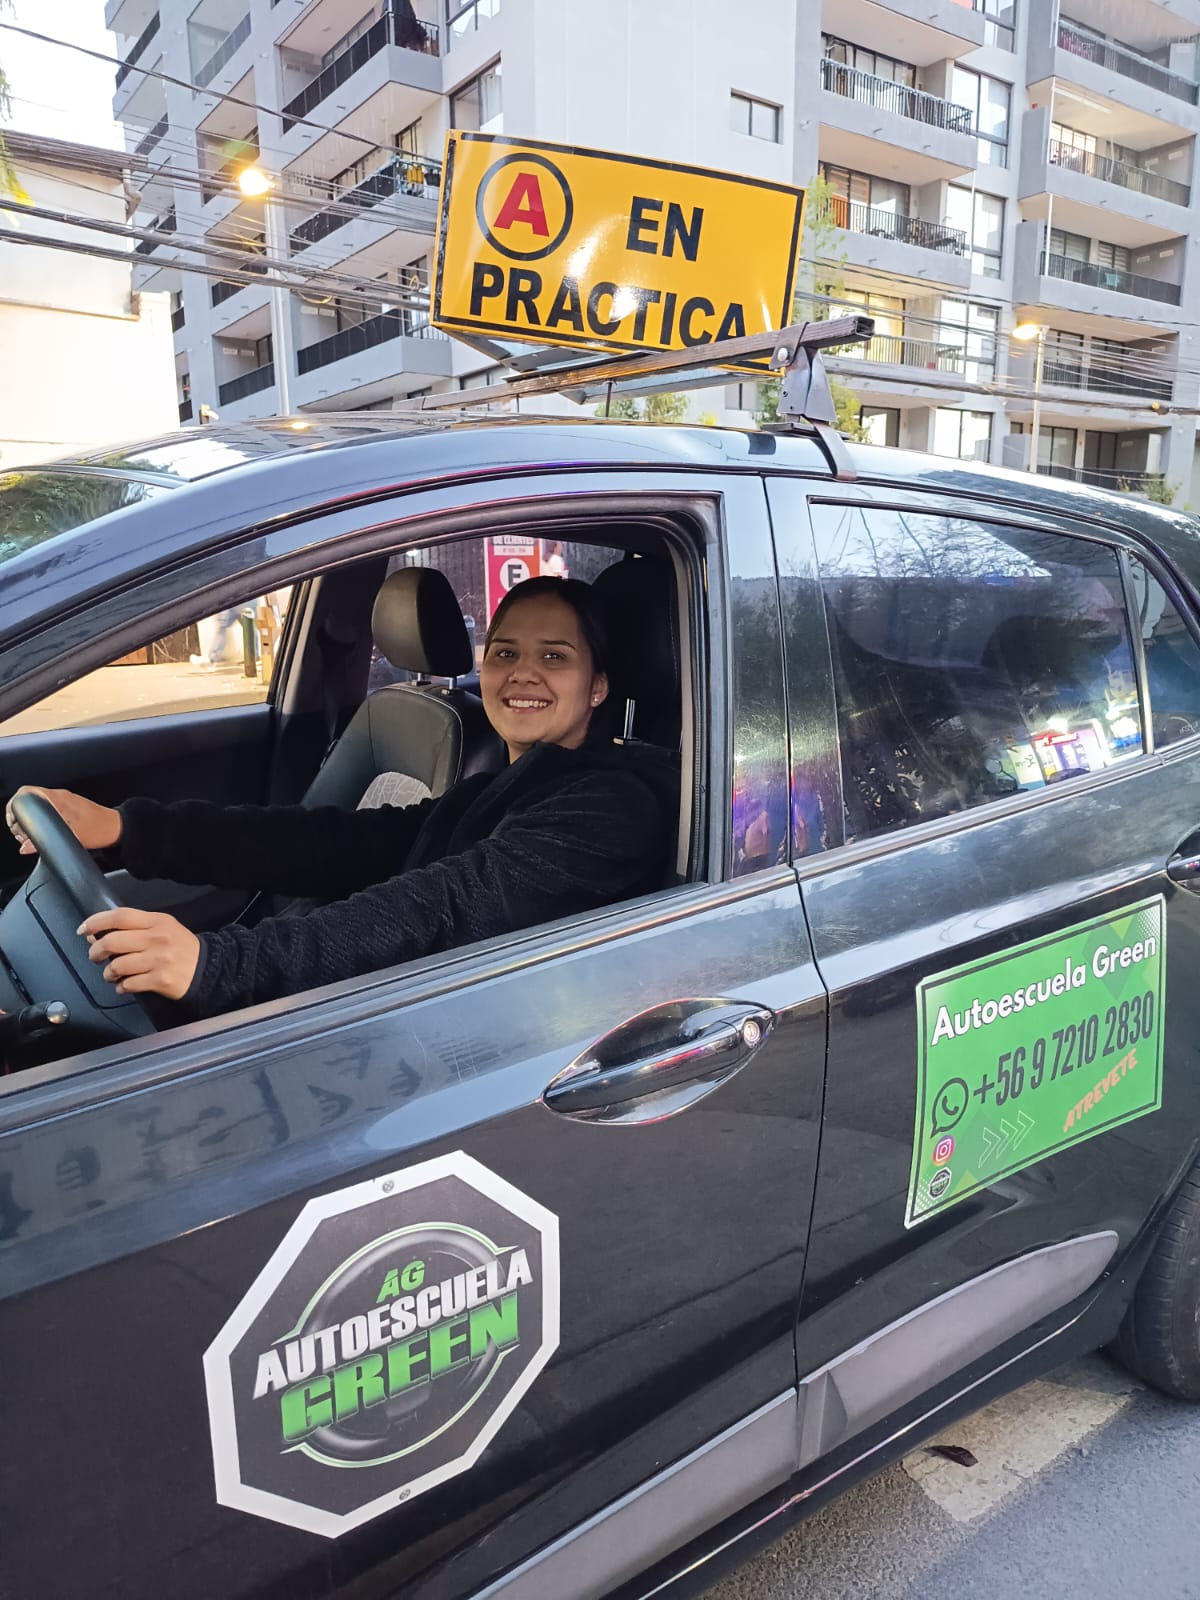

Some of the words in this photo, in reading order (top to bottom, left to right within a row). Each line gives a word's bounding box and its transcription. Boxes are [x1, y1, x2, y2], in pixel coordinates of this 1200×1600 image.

[494, 172, 550, 237] A
[626, 195, 704, 262] EN
[469, 261, 746, 349] PRACTICA
[508, 564, 522, 588] E
[930, 956, 1087, 1047] Autoescuela
[1092, 936, 1157, 980] Green
[973, 1046, 1026, 1106] +56
[1030, 1037, 1047, 1090] 9
[1050, 1014, 1099, 1081] 7210
[1102, 990, 1154, 1057] 2830
[1063, 1047, 1138, 1133] ATREVETE
[252, 1248, 534, 1400] AUTOESCUELA
[376, 1259, 426, 1304] AG
[280, 1292, 520, 1443] GREEN
